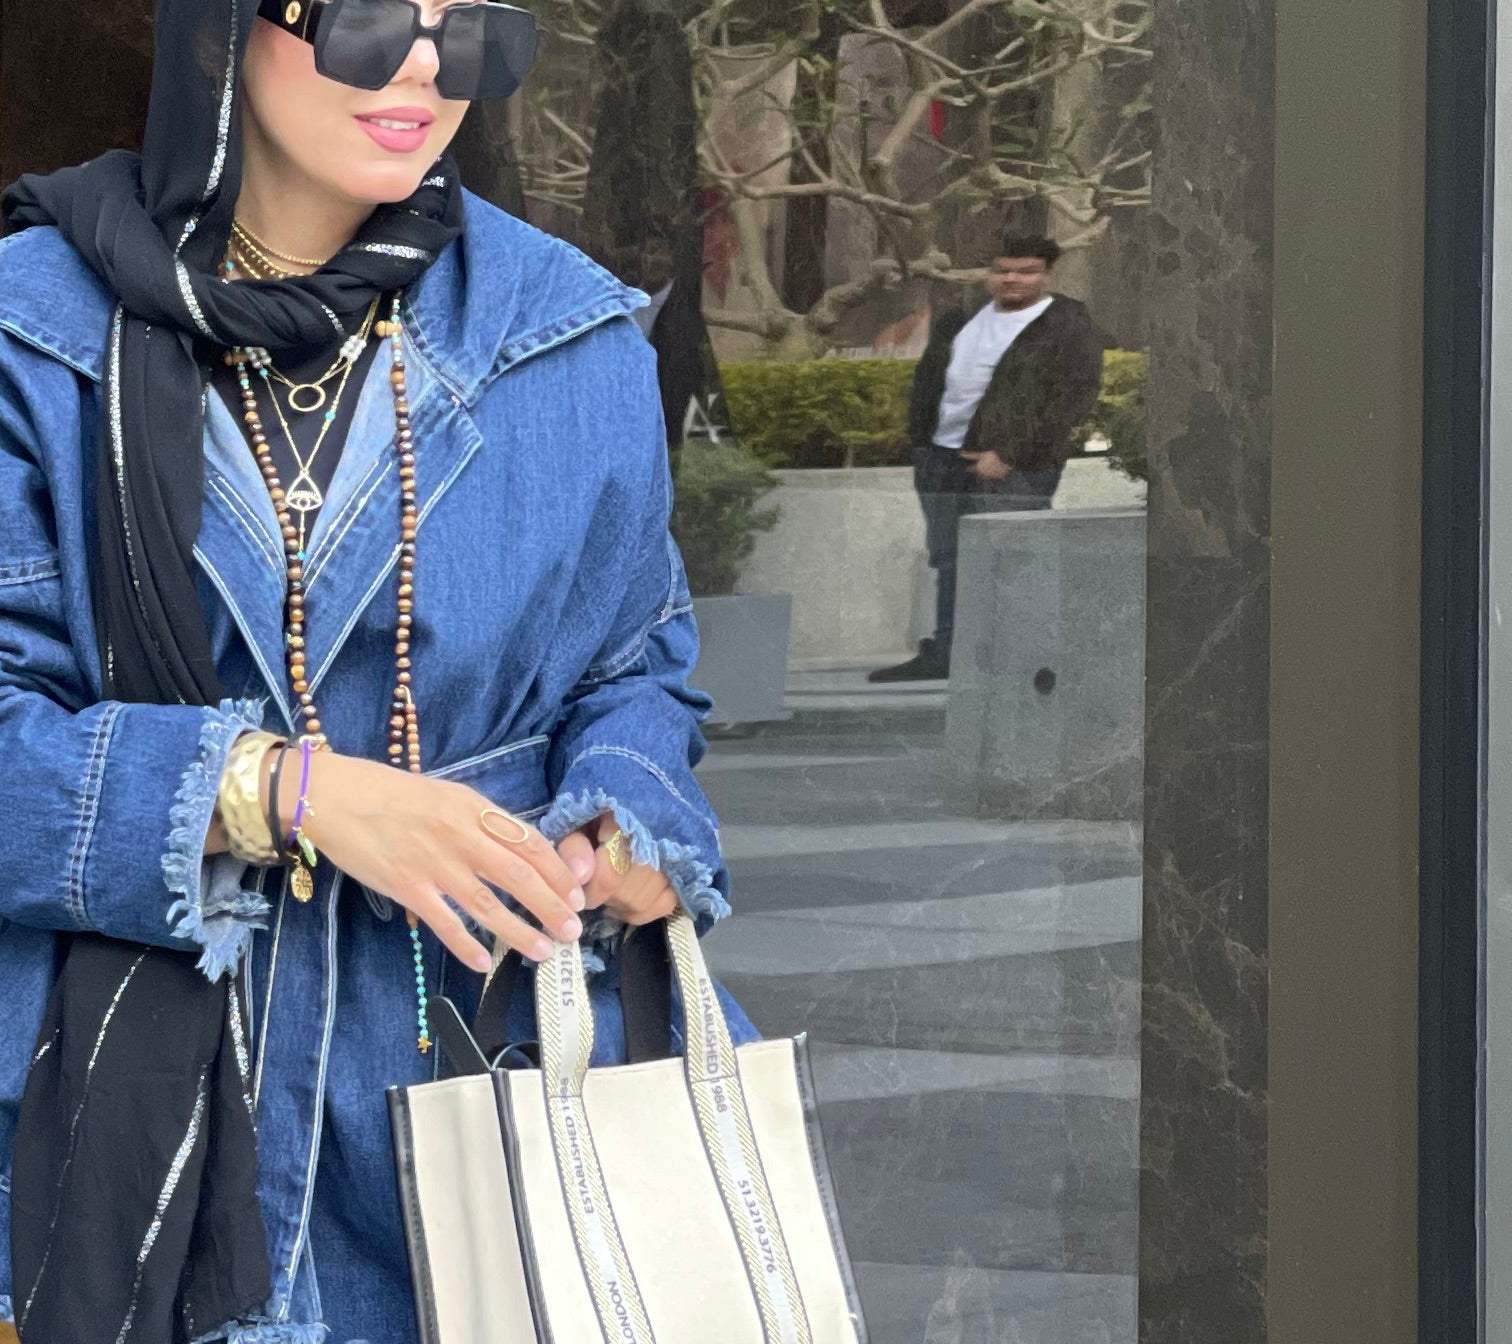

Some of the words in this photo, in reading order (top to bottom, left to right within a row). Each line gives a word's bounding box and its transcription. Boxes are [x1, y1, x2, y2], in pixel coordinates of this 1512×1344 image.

[698, 977, 719, 1074] ESTABLISHED
[709, 1077, 728, 1113] 1988
[565, 1115, 595, 1214] ESTABLISHED
